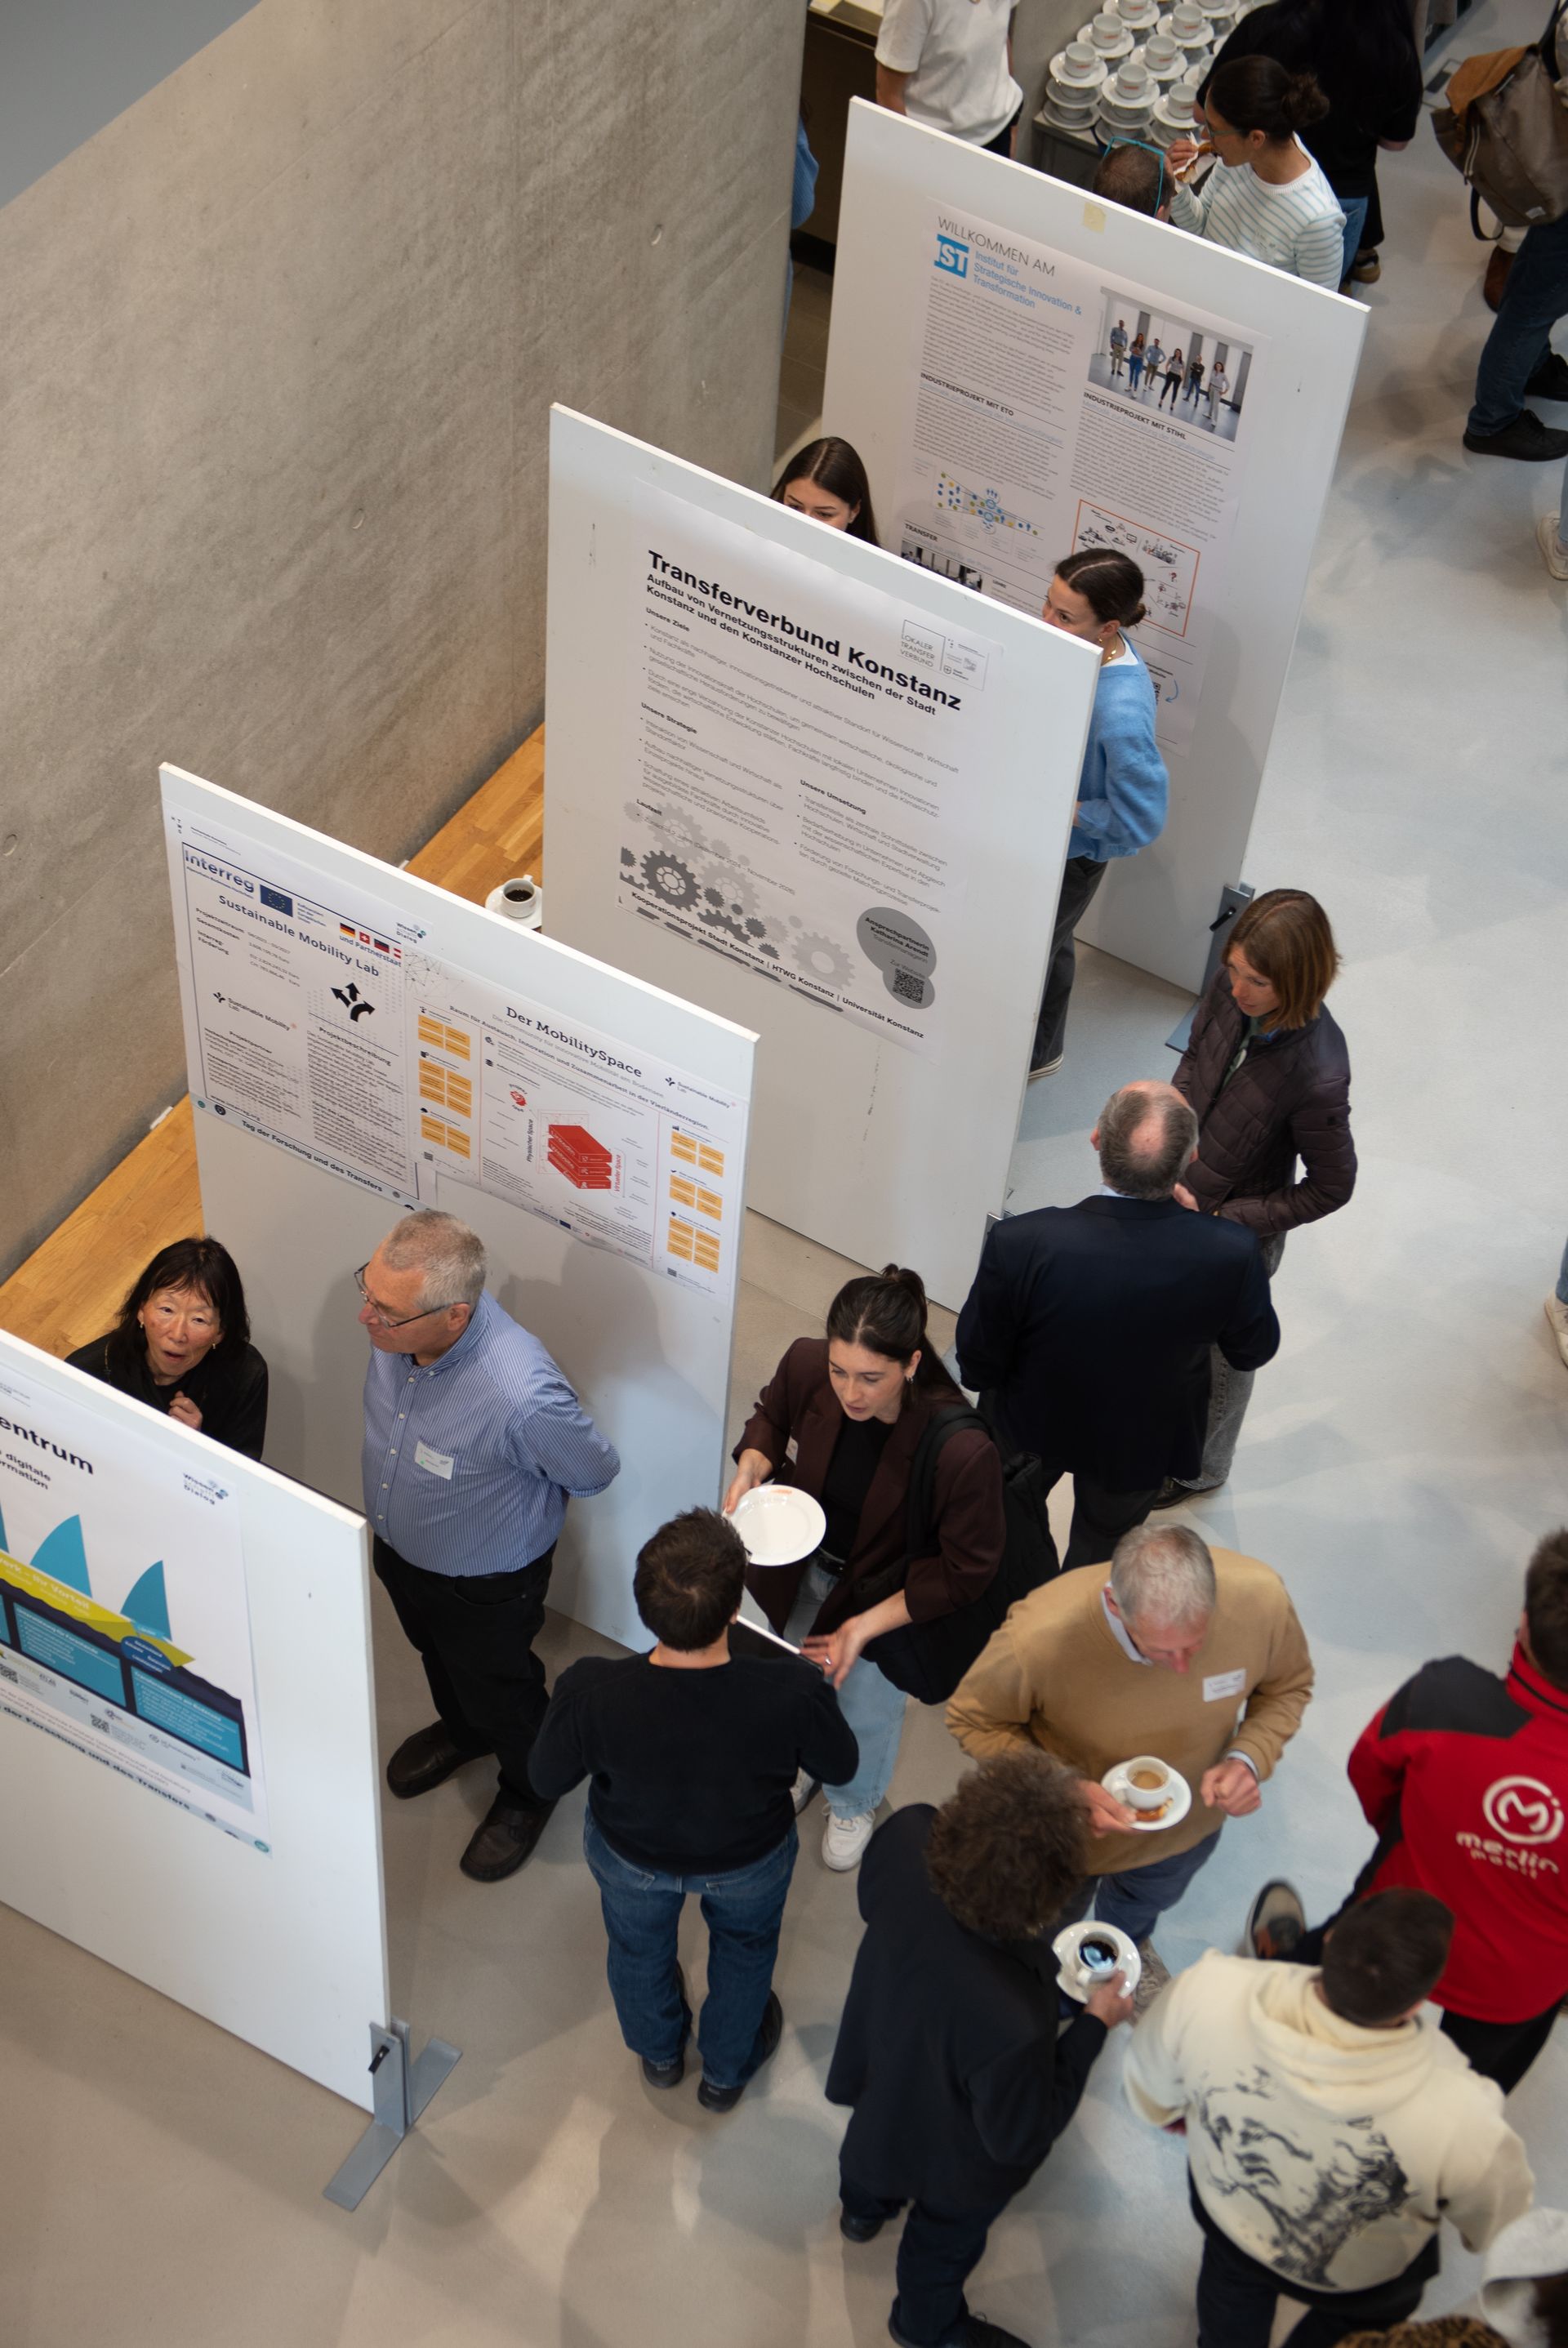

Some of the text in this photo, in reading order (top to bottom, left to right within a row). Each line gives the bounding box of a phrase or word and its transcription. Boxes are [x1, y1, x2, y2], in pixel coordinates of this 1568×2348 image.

[937, 216, 1055, 277] WILLKOMMEN AM
[974, 250, 1019, 277] Institut für
[972, 274, 1036, 309] Transformation
[973, 261, 1082, 316] Strategische Innovation &
[920, 372, 1014, 417] INDUSTRIEPROJEKT MIT ETO
[1083, 391, 1187, 440] INDUSTRIEPROJEKT MIT STIHL
[904, 523, 938, 541] TRANSFER
[645, 607, 690, 632] Unsere Ziele
[647, 549, 840, 657] Transferverbund
[848, 646, 961, 712] Konstanz
[901, 632, 933, 651] LOKALER
[646, 585, 875, 700] Konstanz und den Konstanzer Hochschulen
[647, 573, 935, 715] Aufbau von Vernetzungsstrukturen zwischen der Stadt
[900, 641, 934, 660] TRANSFER
[900, 648, 933, 668] VERBUND
[640, 702, 697, 735] Unsere Strategie
[800, 778, 866, 815] Unsere Umsetzung
[184, 849, 255, 894] Interreg
[218, 893, 295, 938] Sustainable
[298, 931, 352, 967] Mobility
[356, 958, 379, 978] Lab
[339, 934, 401, 968] und Partnerstaat
[395, 929, 417, 944] Dialog
[631, 891, 706, 935] Kooperationsprojekt
[707, 931, 727, 946] Stadt
[729, 942, 764, 965] Konstanz
[771, 963, 795, 980] HTWG
[798, 976, 834, 999] Konstanz
[842, 996, 884, 1021] Universität
[886, 1017, 924, 1039] Konstanz
[228, 997, 290, 1031] Sustainable Mobility
[506, 1005, 532, 1027] Der
[536, 1020, 642, 1078] MobilitySpace
[449, 1005, 469, 1018] Raum
[470, 1014, 480, 1023] für
[482, 1020, 517, 1041] Austausch,
[518, 1037, 555, 1060] Innovation
[556, 1055, 570, 1067] und
[571, 1063, 627, 1094] Zusammenarbeit
[637, 1094, 648, 1103] der
[649, 1099, 710, 1130] Vierländerregion.
[241, 1119, 382, 1193] Tag der Forschung und des Transfers
[0, 1416, 94, 1475] entrum
[6, 1453, 51, 1481] digitale
[0, 1460, 49, 1490] rmation
[4, 1705, 191, 1811] der Forschung und des Transfers
[1455, 1831, 1560, 1875] merlin
